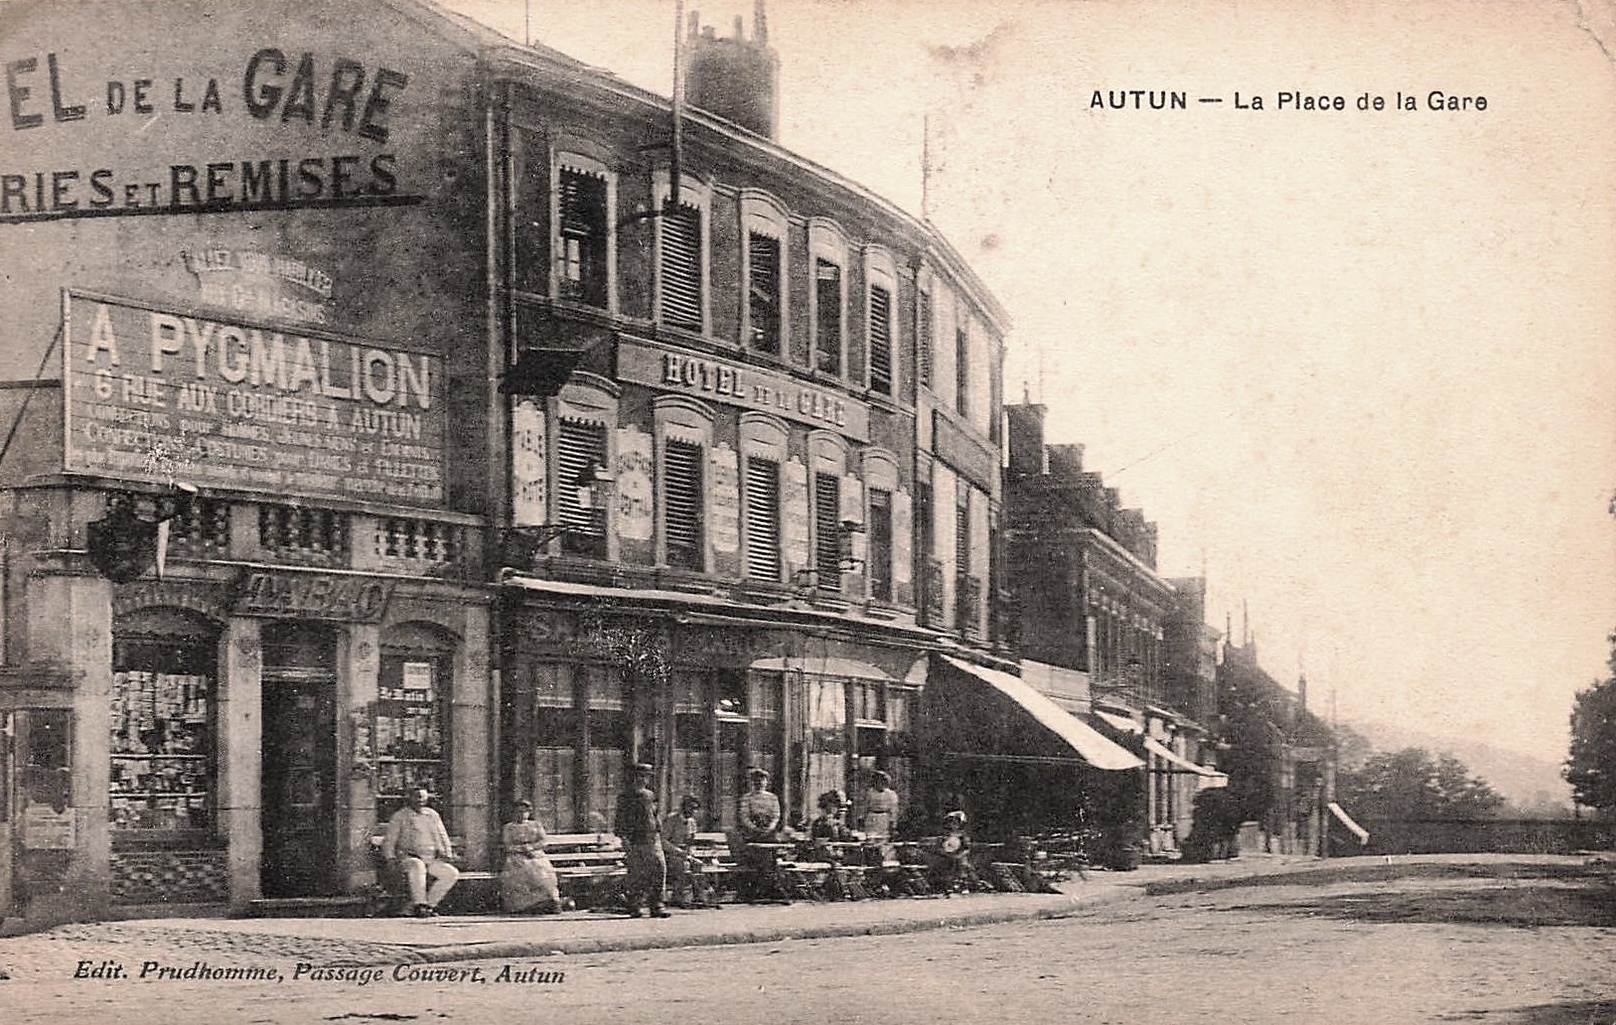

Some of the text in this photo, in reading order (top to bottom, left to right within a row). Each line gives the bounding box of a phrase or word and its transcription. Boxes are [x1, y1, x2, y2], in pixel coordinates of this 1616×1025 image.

[105, 79, 153, 116] DE
[174, 77, 223, 115] LA
[244, 48, 409, 144] GARE
[124, 181, 162, 208] ET
[170, 154, 397, 203] REMISES
[151, 311, 430, 410] PYGMALION
[664, 353, 745, 398] HOTEL
[122, 373, 165, 408] RUE
[178, 381, 217, 414] AUX
[353, 405, 421, 440] AUTUN
